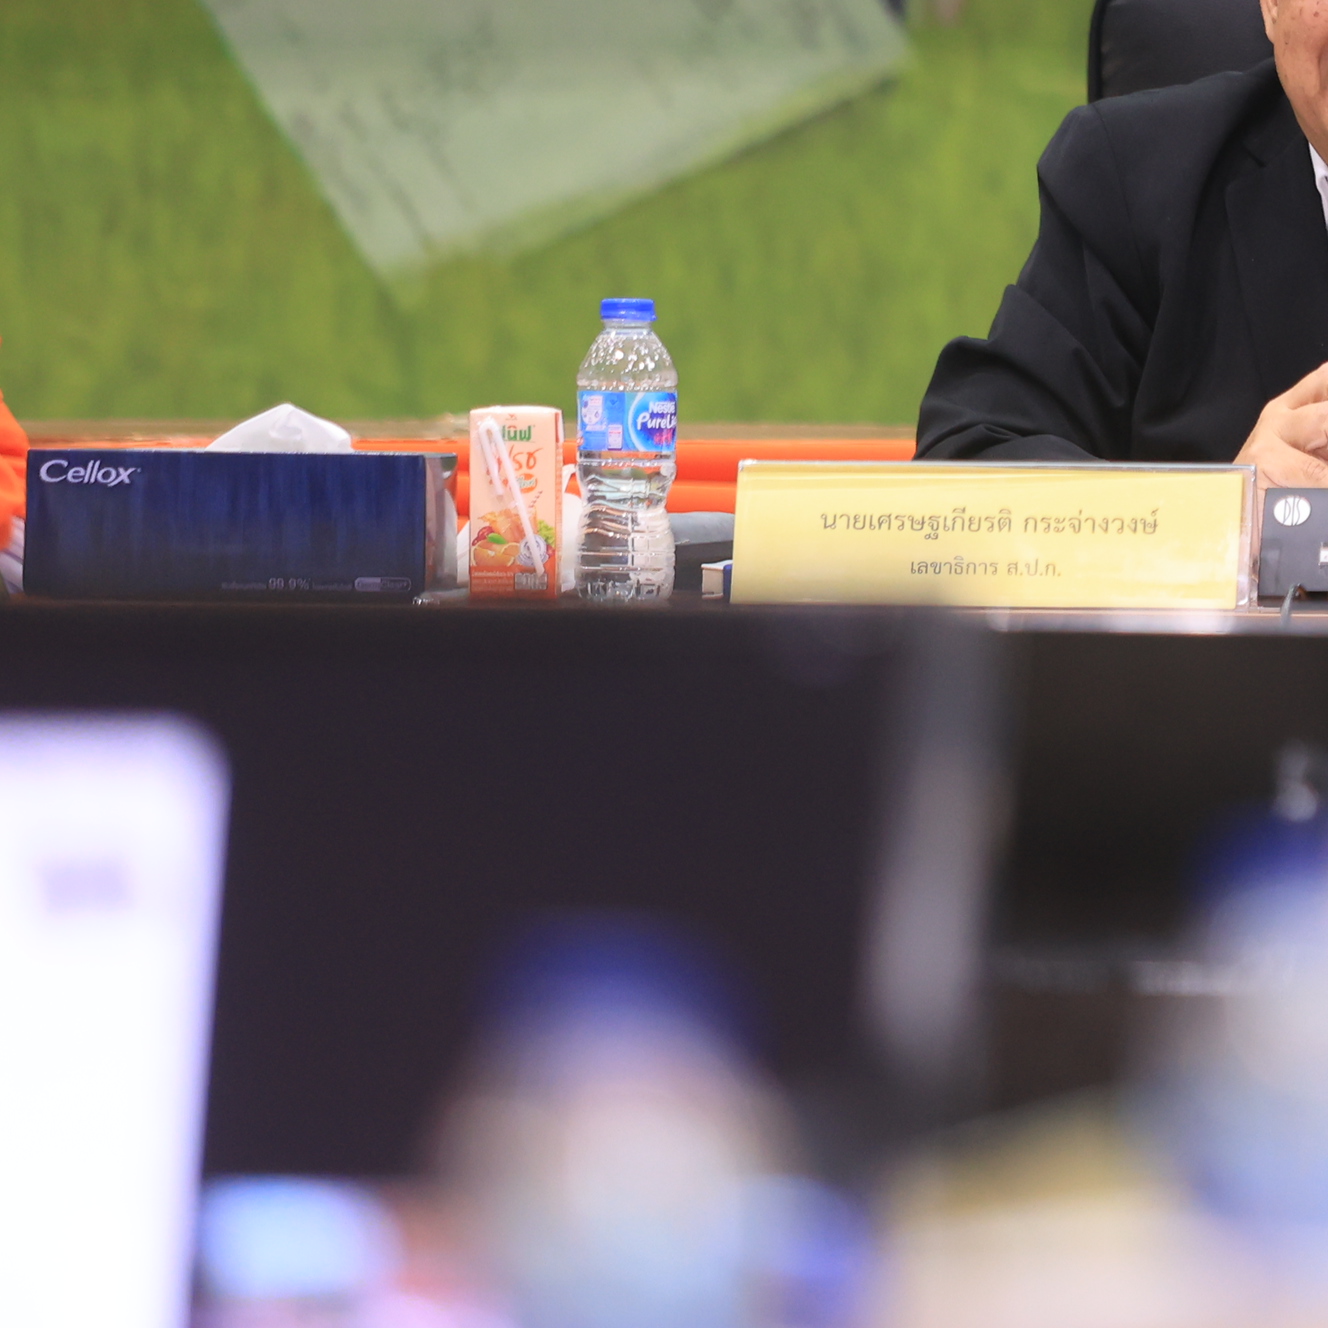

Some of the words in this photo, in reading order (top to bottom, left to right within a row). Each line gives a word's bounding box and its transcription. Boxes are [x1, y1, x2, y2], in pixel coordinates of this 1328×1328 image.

[40, 459, 136, 487] Cellox
[819, 506, 1013, 540] นายเศรษฐเกียรติ
[1023, 507, 1160, 535] กระจ่างวงษ์
[909, 555, 999, 576] เลขาธิการ
[1006, 558, 1062, 577] ส.ป.ก.
